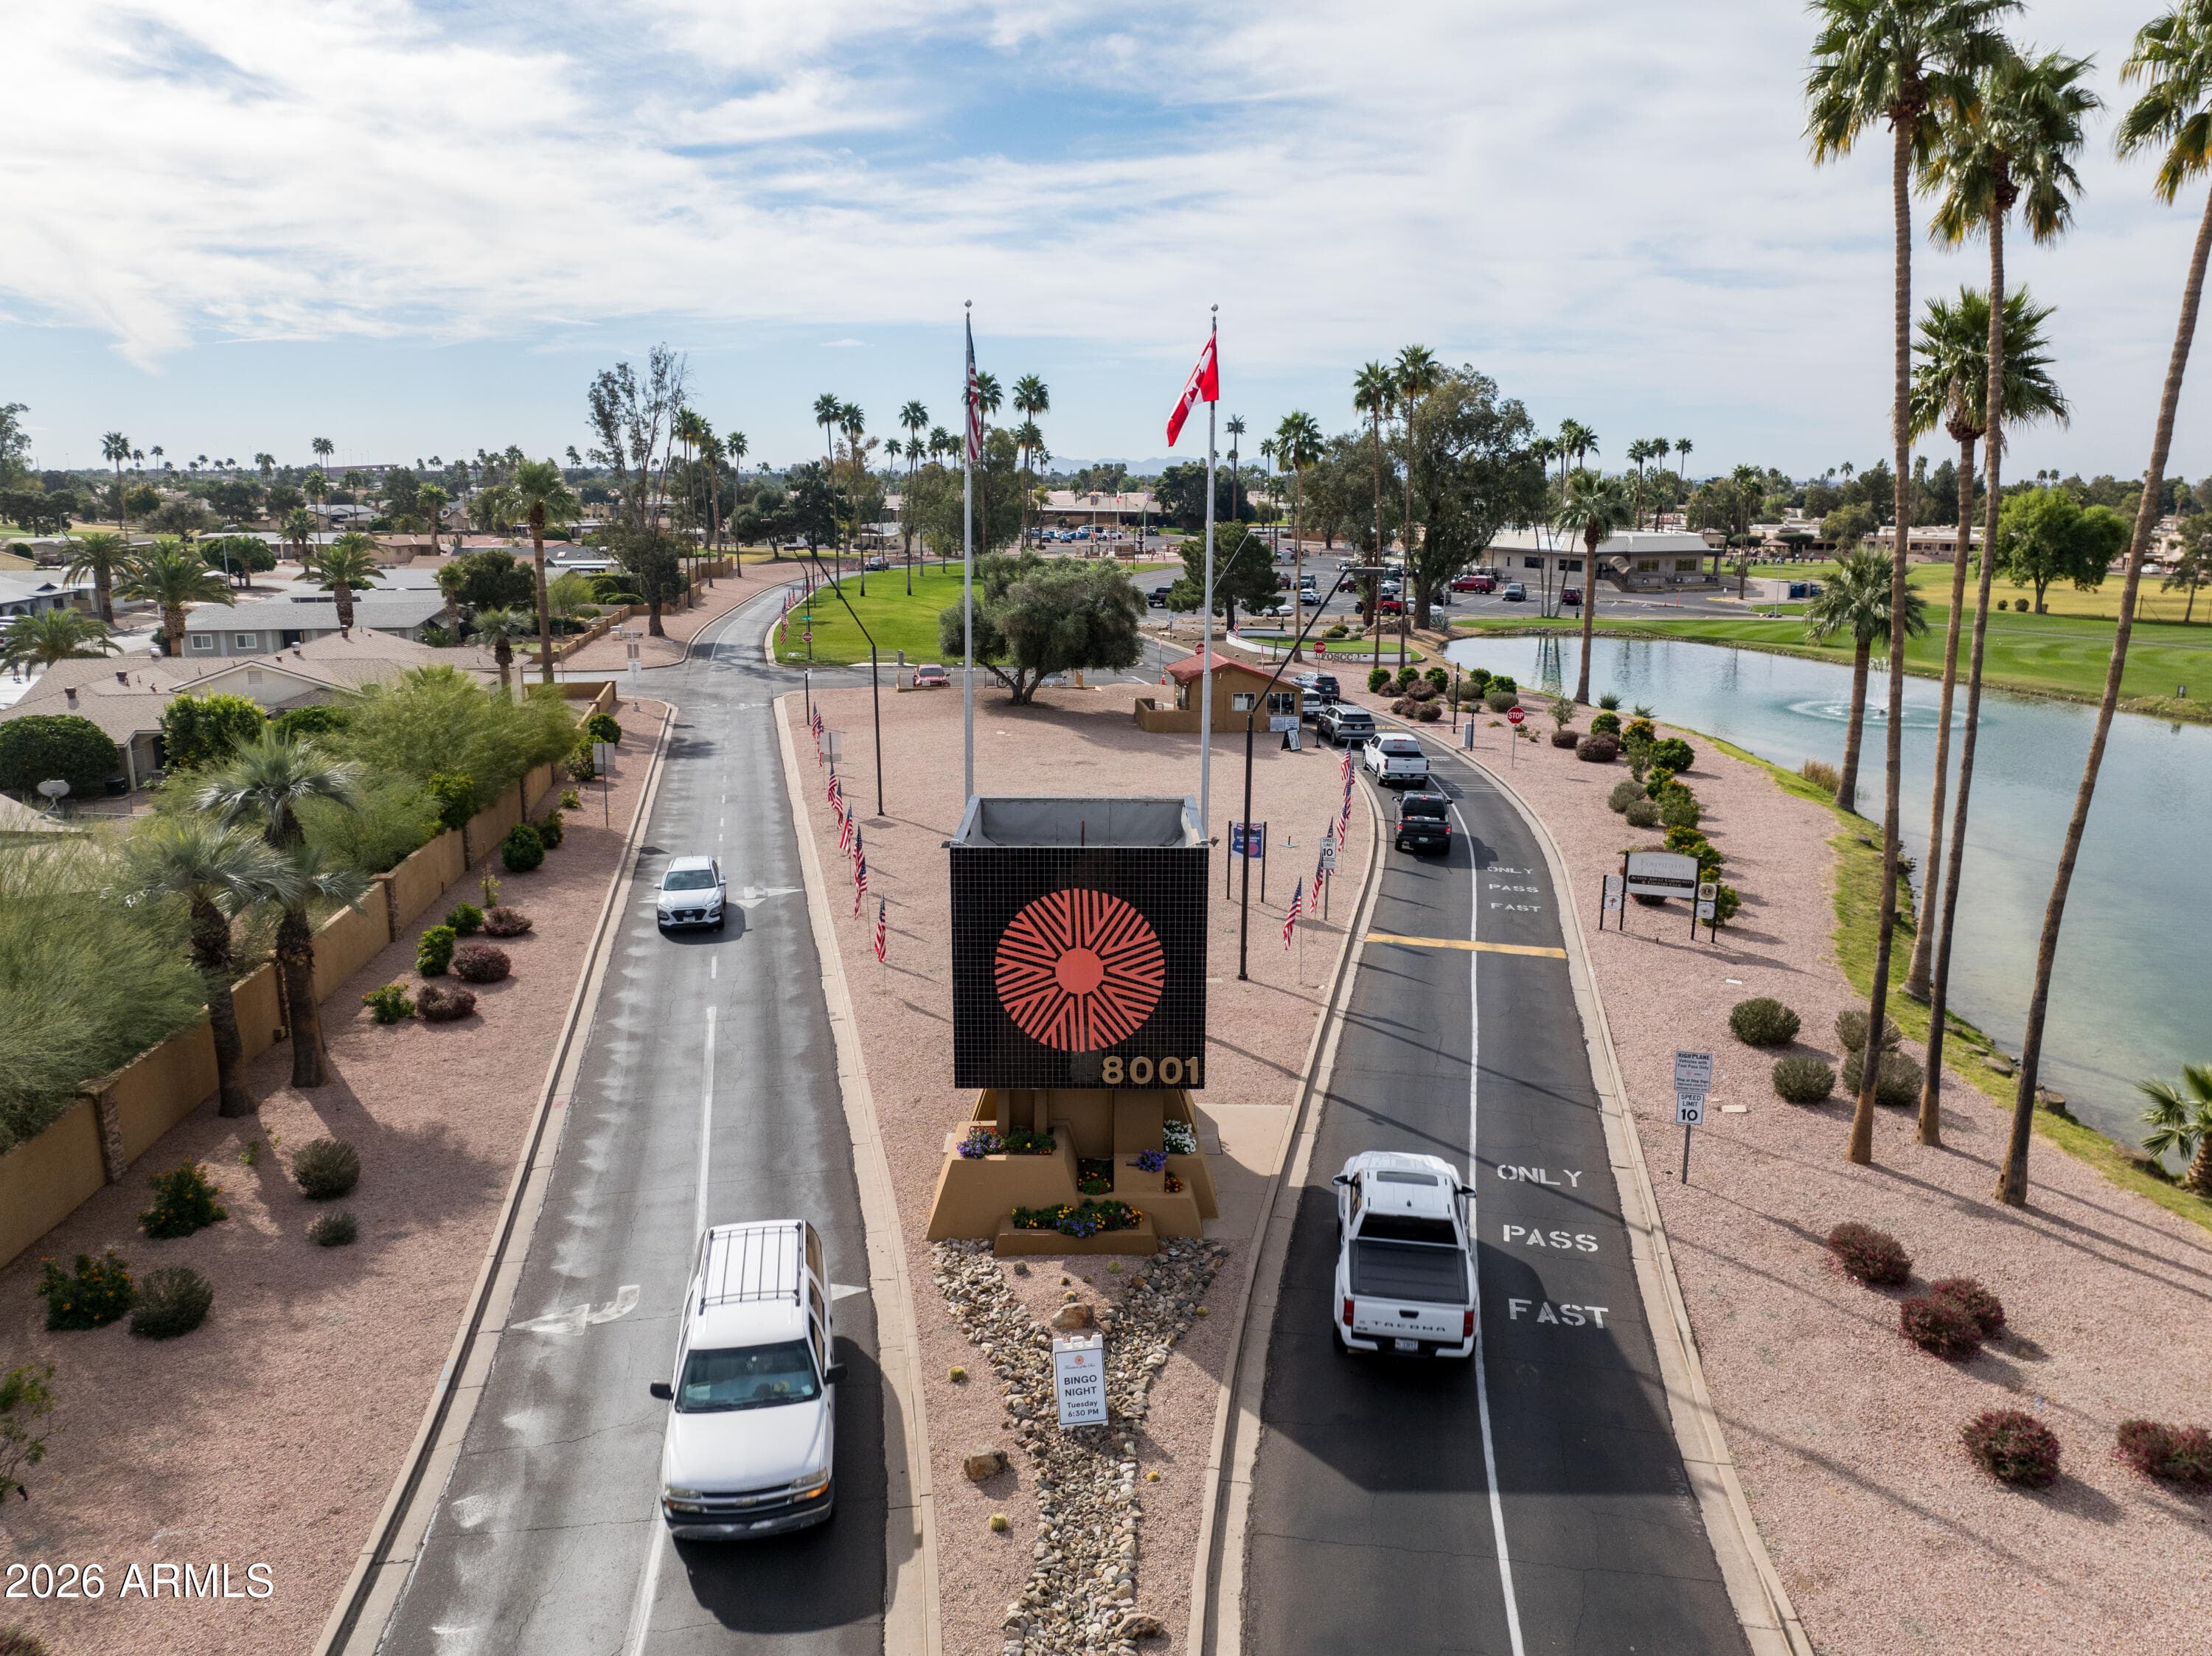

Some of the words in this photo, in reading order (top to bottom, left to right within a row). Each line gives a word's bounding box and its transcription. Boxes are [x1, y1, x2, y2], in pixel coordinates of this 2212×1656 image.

[1321, 653, 1354, 661] FOSCC
[1323, 848, 1333, 856] 10
[1641, 858, 1685, 870] Fountain
[1486, 866, 1534, 874] ONLY
[1489, 883, 1539, 893] PASS
[1490, 902, 1542, 913] FAST
[1102, 1055, 1199, 1085] 8001
[1681, 1108, 1698, 1121] 10
[1497, 1164, 1582, 1187] ONLY
[1503, 1225, 1599, 1252] PASS
[1508, 1298, 1609, 1329] FAST
[1371, 1320, 1445, 1332] TACOMA
[1064, 1374, 1097, 1385] BINGO
[1065, 1386, 1097, 1396] NIGHT
[1066, 1400, 1097, 1408] Tuesday
